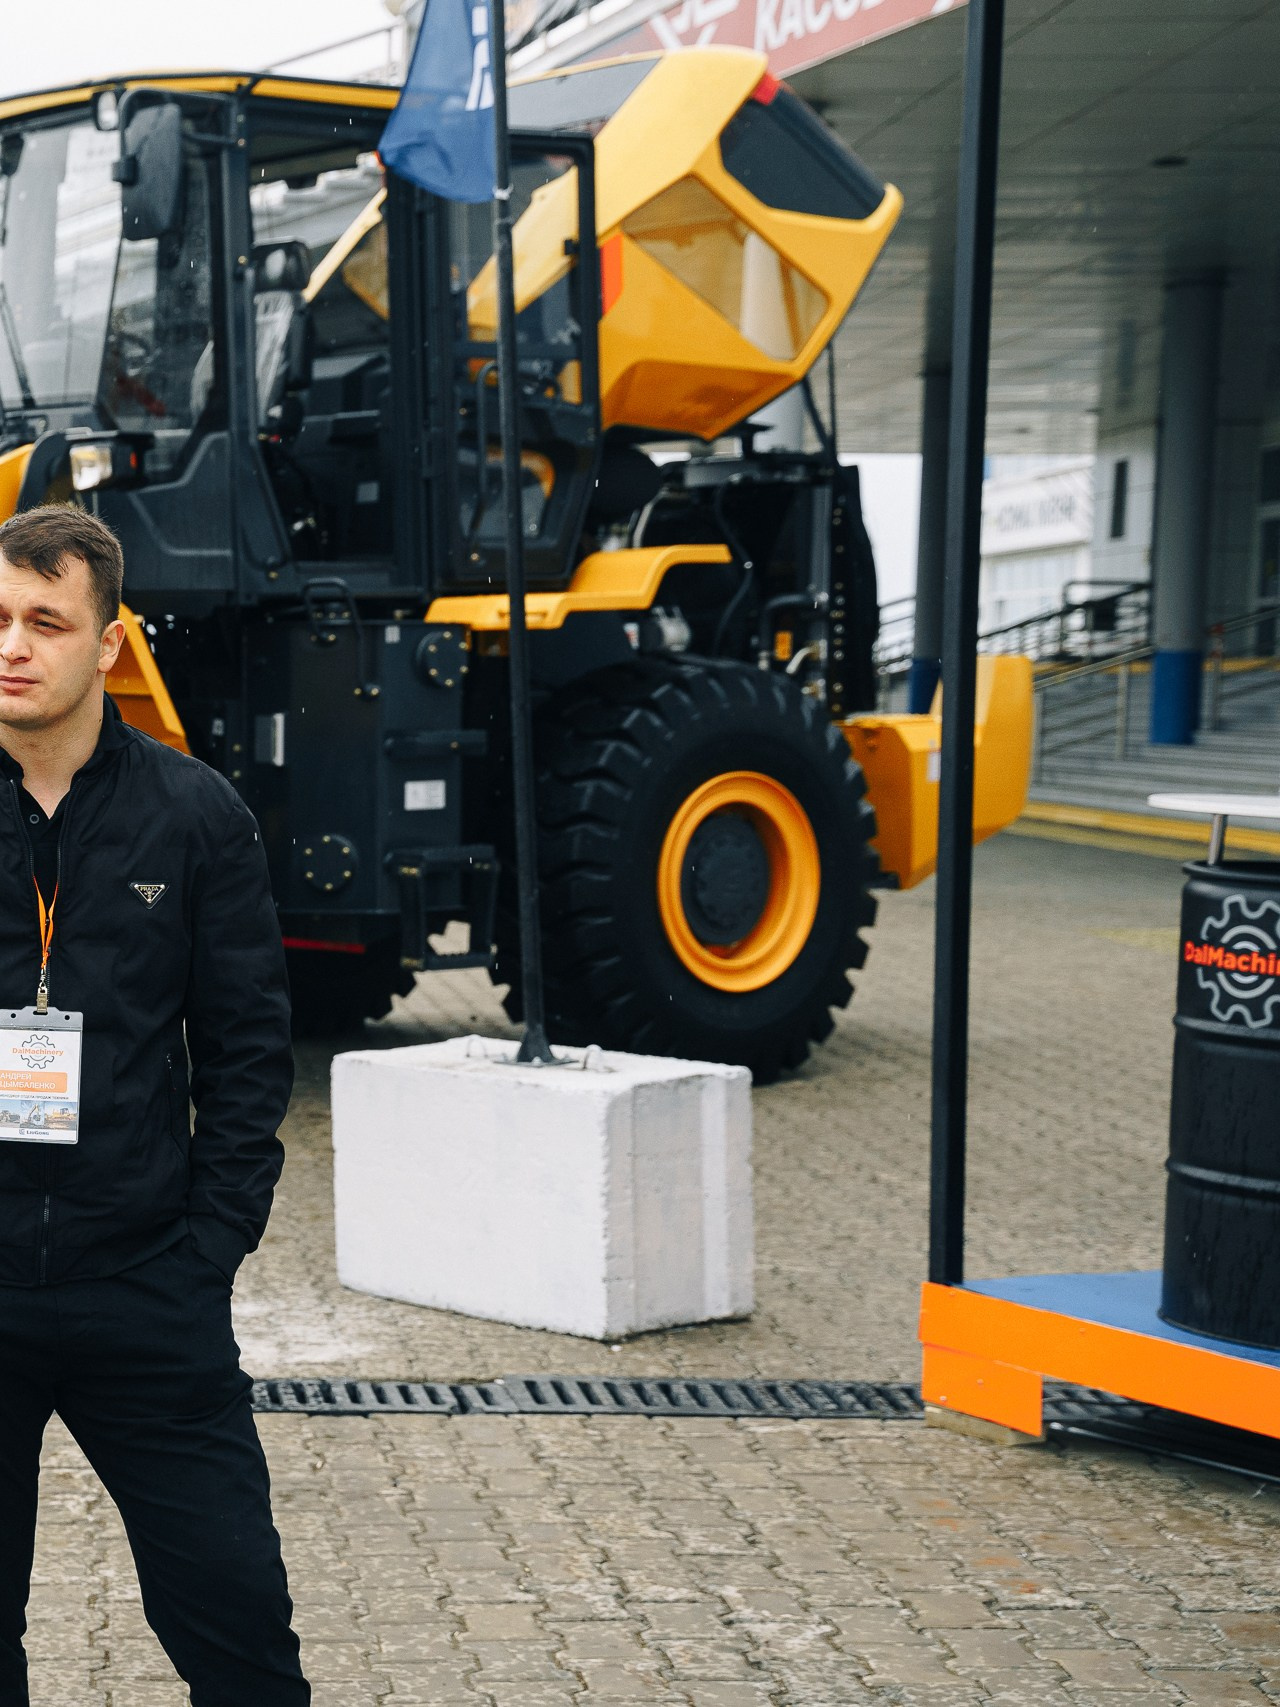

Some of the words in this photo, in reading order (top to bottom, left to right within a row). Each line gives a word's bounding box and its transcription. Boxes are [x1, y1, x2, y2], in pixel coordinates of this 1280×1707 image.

[1184, 940, 1280, 976] DalMachi
[12, 1047, 64, 1056] DalMachinery
[0, 1072, 32, 1080] АНДРЕЙ
[0, 1081, 56, 1089] ЦЫМБАЛЕНКО
